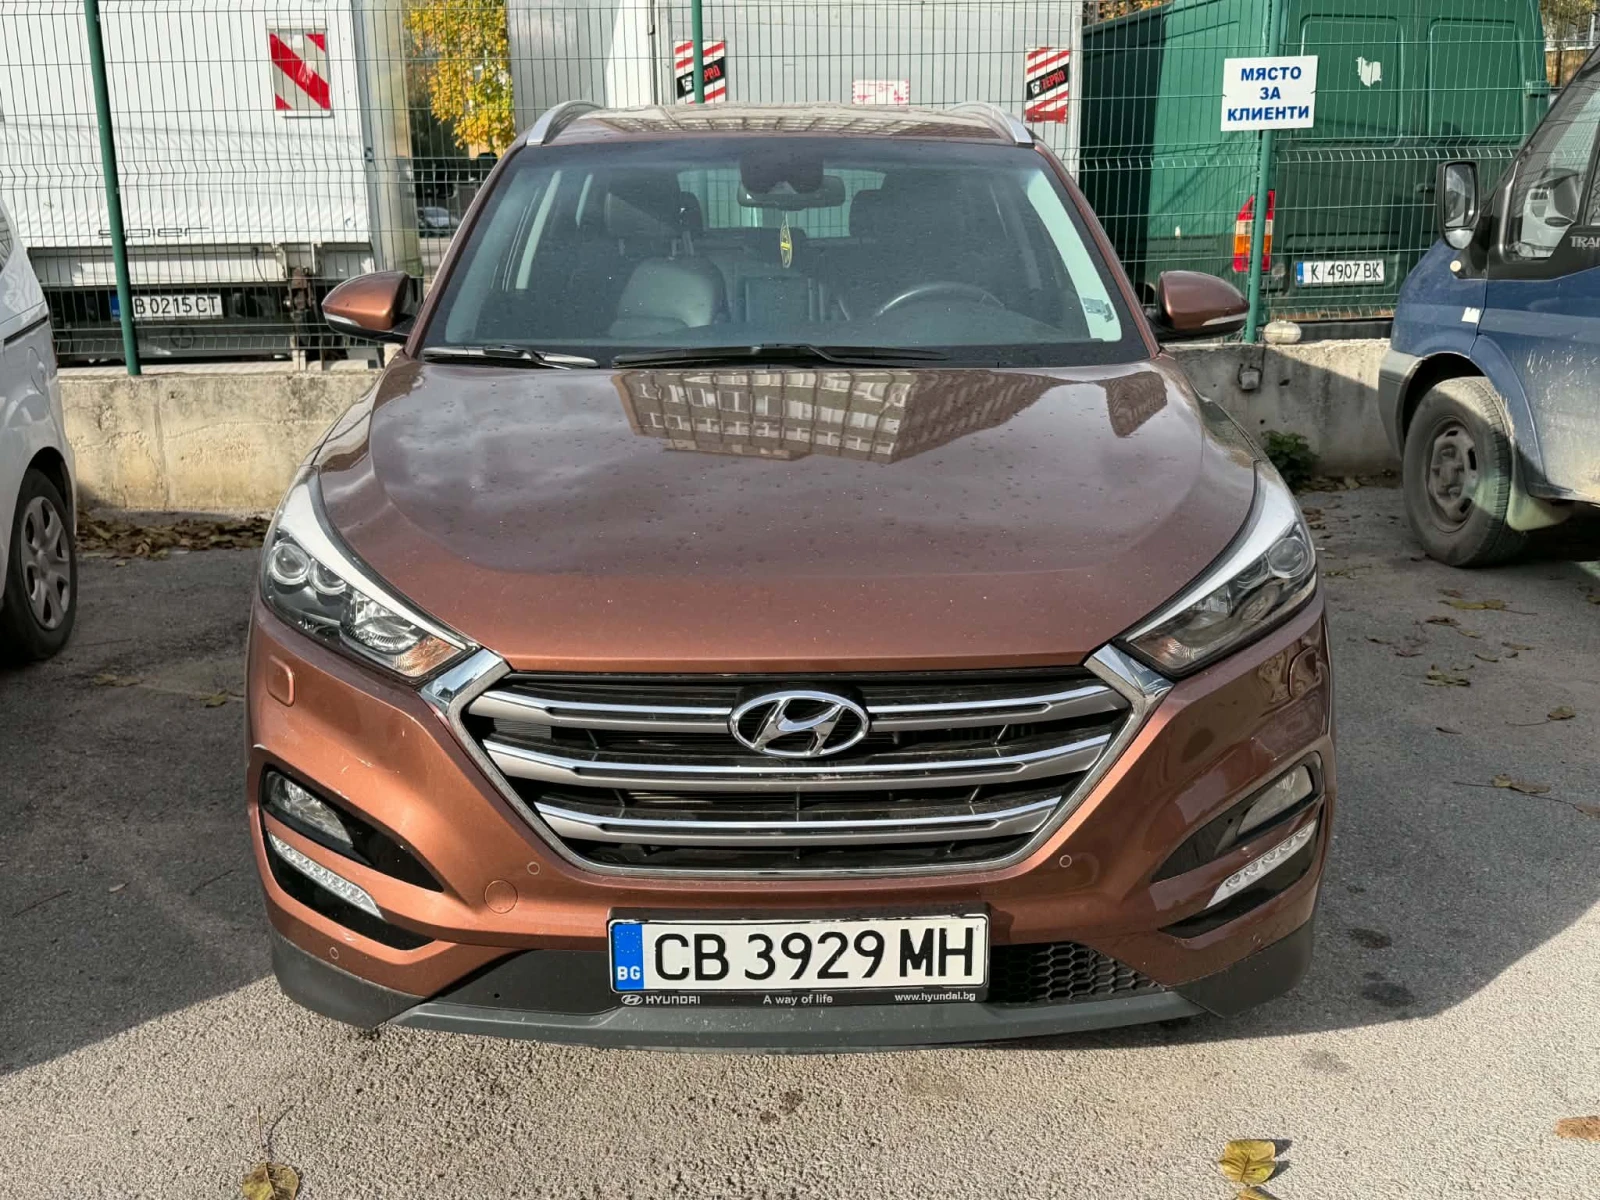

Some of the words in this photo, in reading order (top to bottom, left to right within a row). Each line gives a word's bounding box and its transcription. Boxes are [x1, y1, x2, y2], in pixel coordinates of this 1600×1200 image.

[1241, 66, 1302, 81] МЯСТО
[1259, 87, 1281, 100] ЗА
[1227, 105, 1310, 121] КЛИЕНТИ
[1311, 264, 1319, 281] K
[1327, 263, 1360, 280] 4907
[1363, 262, 1381, 279] BK
[150, 297, 192, 314] 0215
[195, 296, 217, 313] CT
[616, 965, 641, 981] BG
[655, 934, 729, 981] CB
[744, 930, 885, 980] 3929
[899, 927, 974, 978] MH
[645, 995, 701, 1005] HYUNDAI
[763, 994, 772, 1005] A
[775, 996, 799, 1007] way
[801, 994, 814, 1005] of
[816, 993, 833, 1004] life
[894, 991, 976, 1002] www.hyundai.bg
